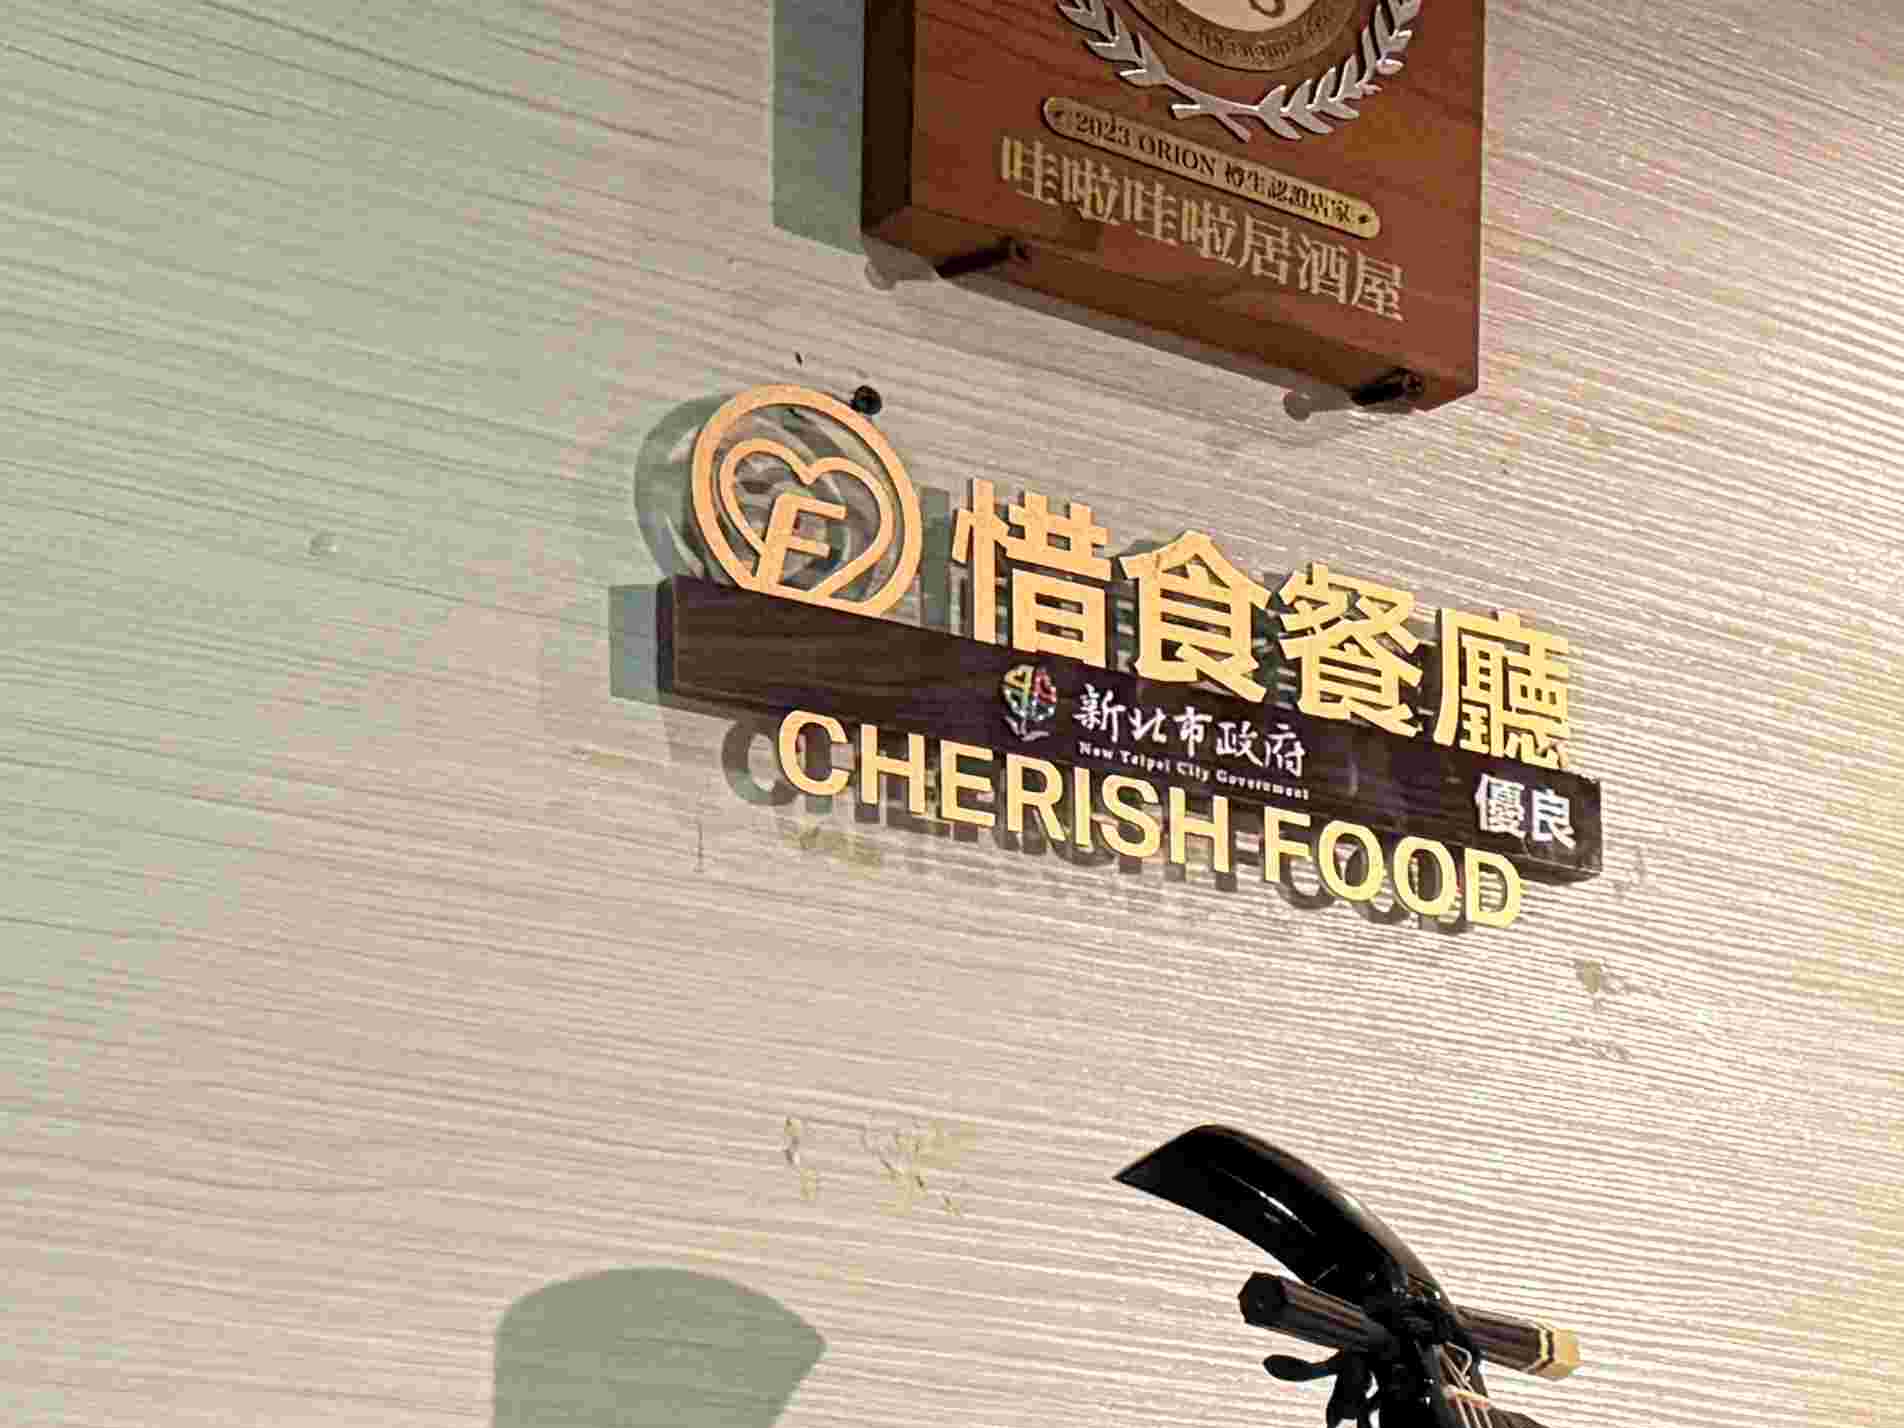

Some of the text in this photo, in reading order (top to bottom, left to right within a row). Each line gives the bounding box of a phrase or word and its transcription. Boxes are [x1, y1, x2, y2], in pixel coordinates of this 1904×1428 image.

[1074, 110, 1131, 147] 2023
[1138, 134, 1217, 178] ORION
[1000, 134, 1404, 323] 哇啦哇啦居酒屋
[951, 476, 1574, 771] 惜食餐廳
[1072, 683, 1307, 778] 新北市政府
[1079, 740, 1310, 801] New Taipei City Government
[776, 708, 1525, 932] CHERISH FOOD
[1473, 770, 1577, 850] 優良
